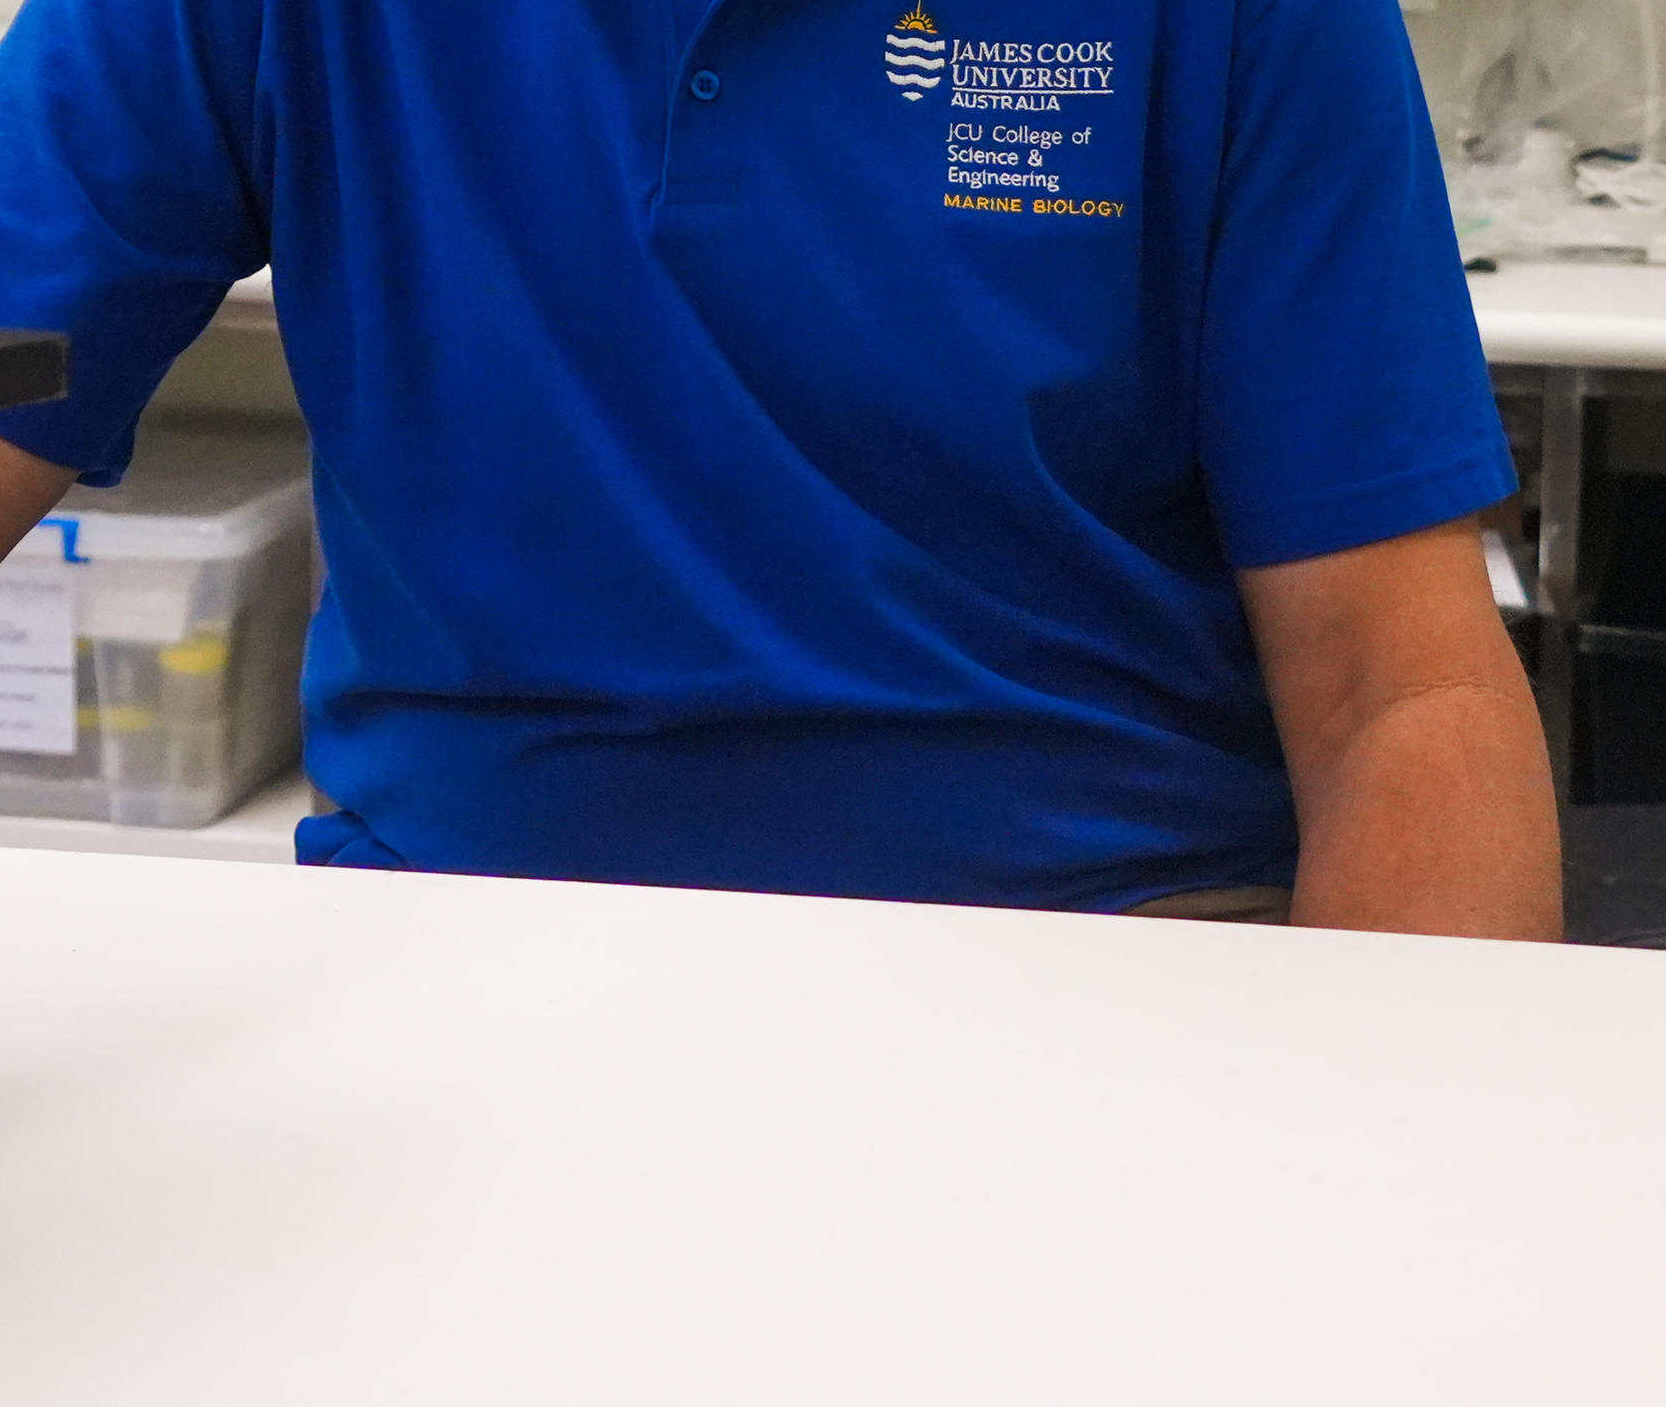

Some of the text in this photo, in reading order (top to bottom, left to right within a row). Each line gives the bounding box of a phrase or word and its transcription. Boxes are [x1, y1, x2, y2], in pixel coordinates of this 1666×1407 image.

[950, 39, 1113, 64] JAMES COOK
[951, 64, 1114, 88] UNIVERSITY
[951, 94, 1061, 111] AUSTRALIA
[946, 123, 1092, 149] JCU College of
[947, 145, 1043, 167] Science &
[948, 165, 1060, 192] Engineering
[943, 193, 1125, 217] MARINE BIOLOGY
